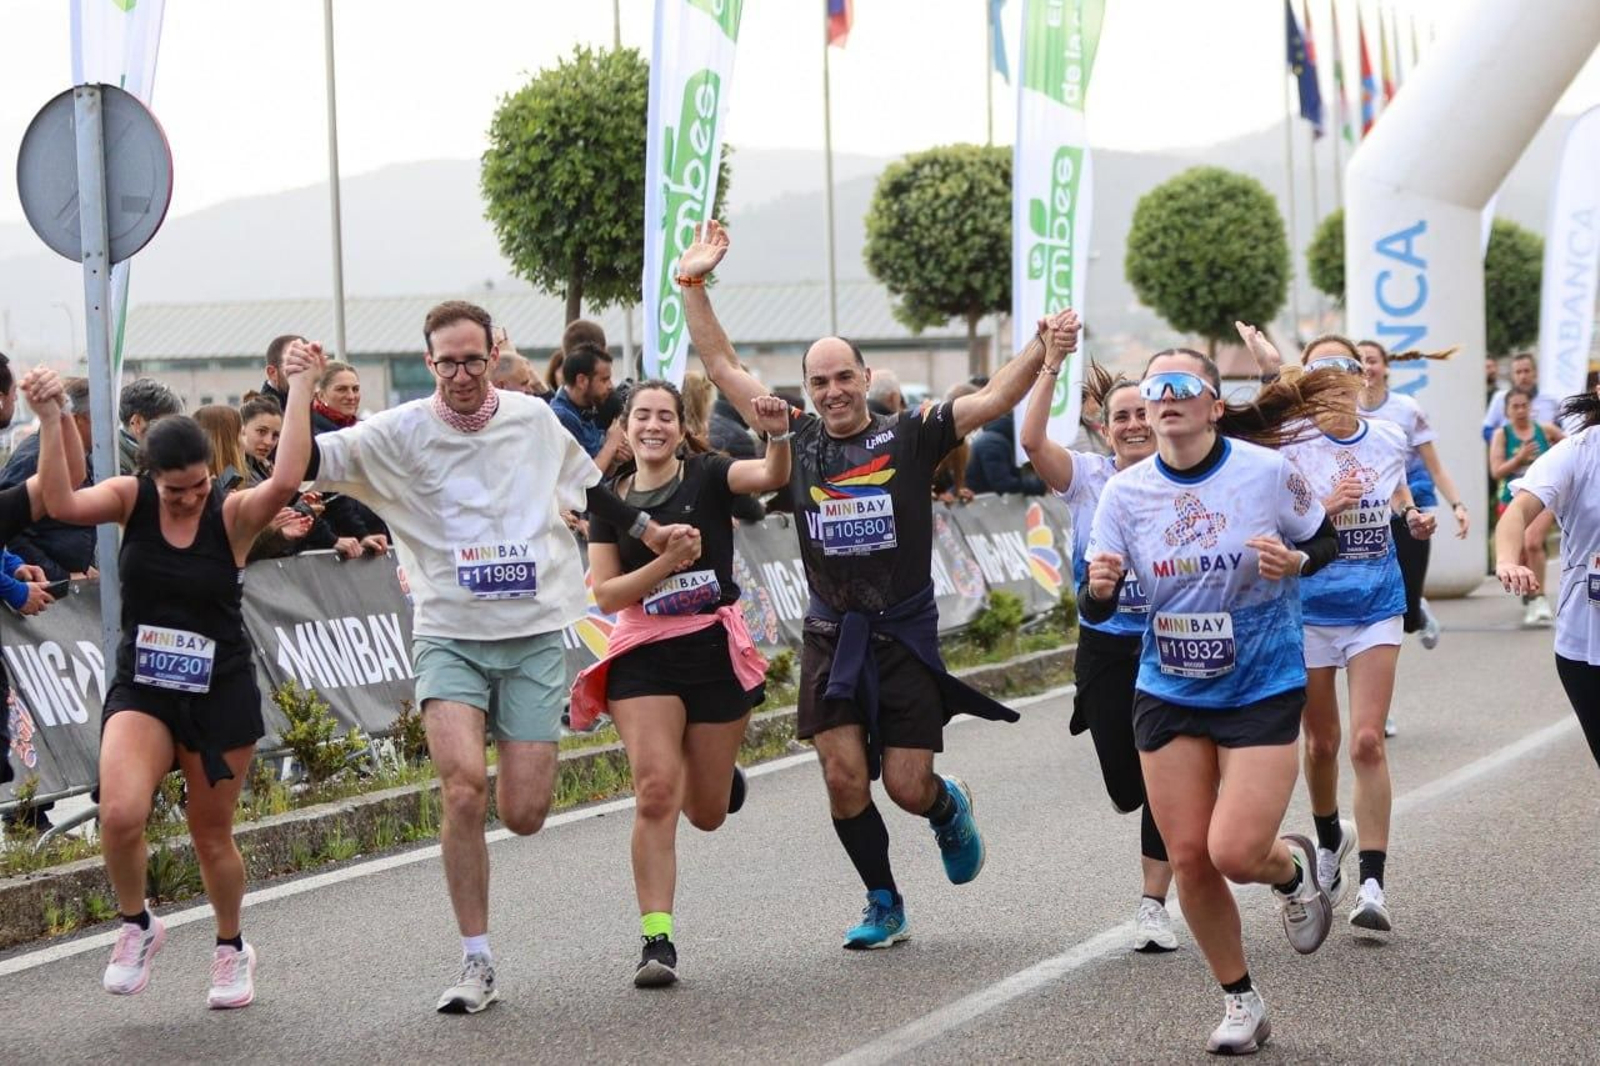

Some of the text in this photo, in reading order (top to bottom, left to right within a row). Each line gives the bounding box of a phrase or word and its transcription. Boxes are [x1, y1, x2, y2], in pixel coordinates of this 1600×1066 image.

[1556, 207, 1595, 372] ABANCA
[825, 499, 886, 517] MINIBAY
[835, 518, 886, 538] 10580
[1337, 528, 1385, 545] 1925
[461, 544, 529, 561] MINIBAY
[472, 564, 528, 584] 11989
[1153, 552, 1242, 578] MINIBAY
[1158, 617, 1225, 633] MINIBAY
[141, 630, 209, 651] MINIBAY
[1169, 640, 1225, 659] 11932
[275, 612, 414, 691] MINIBAY
[149, 653, 202, 675] 10730
